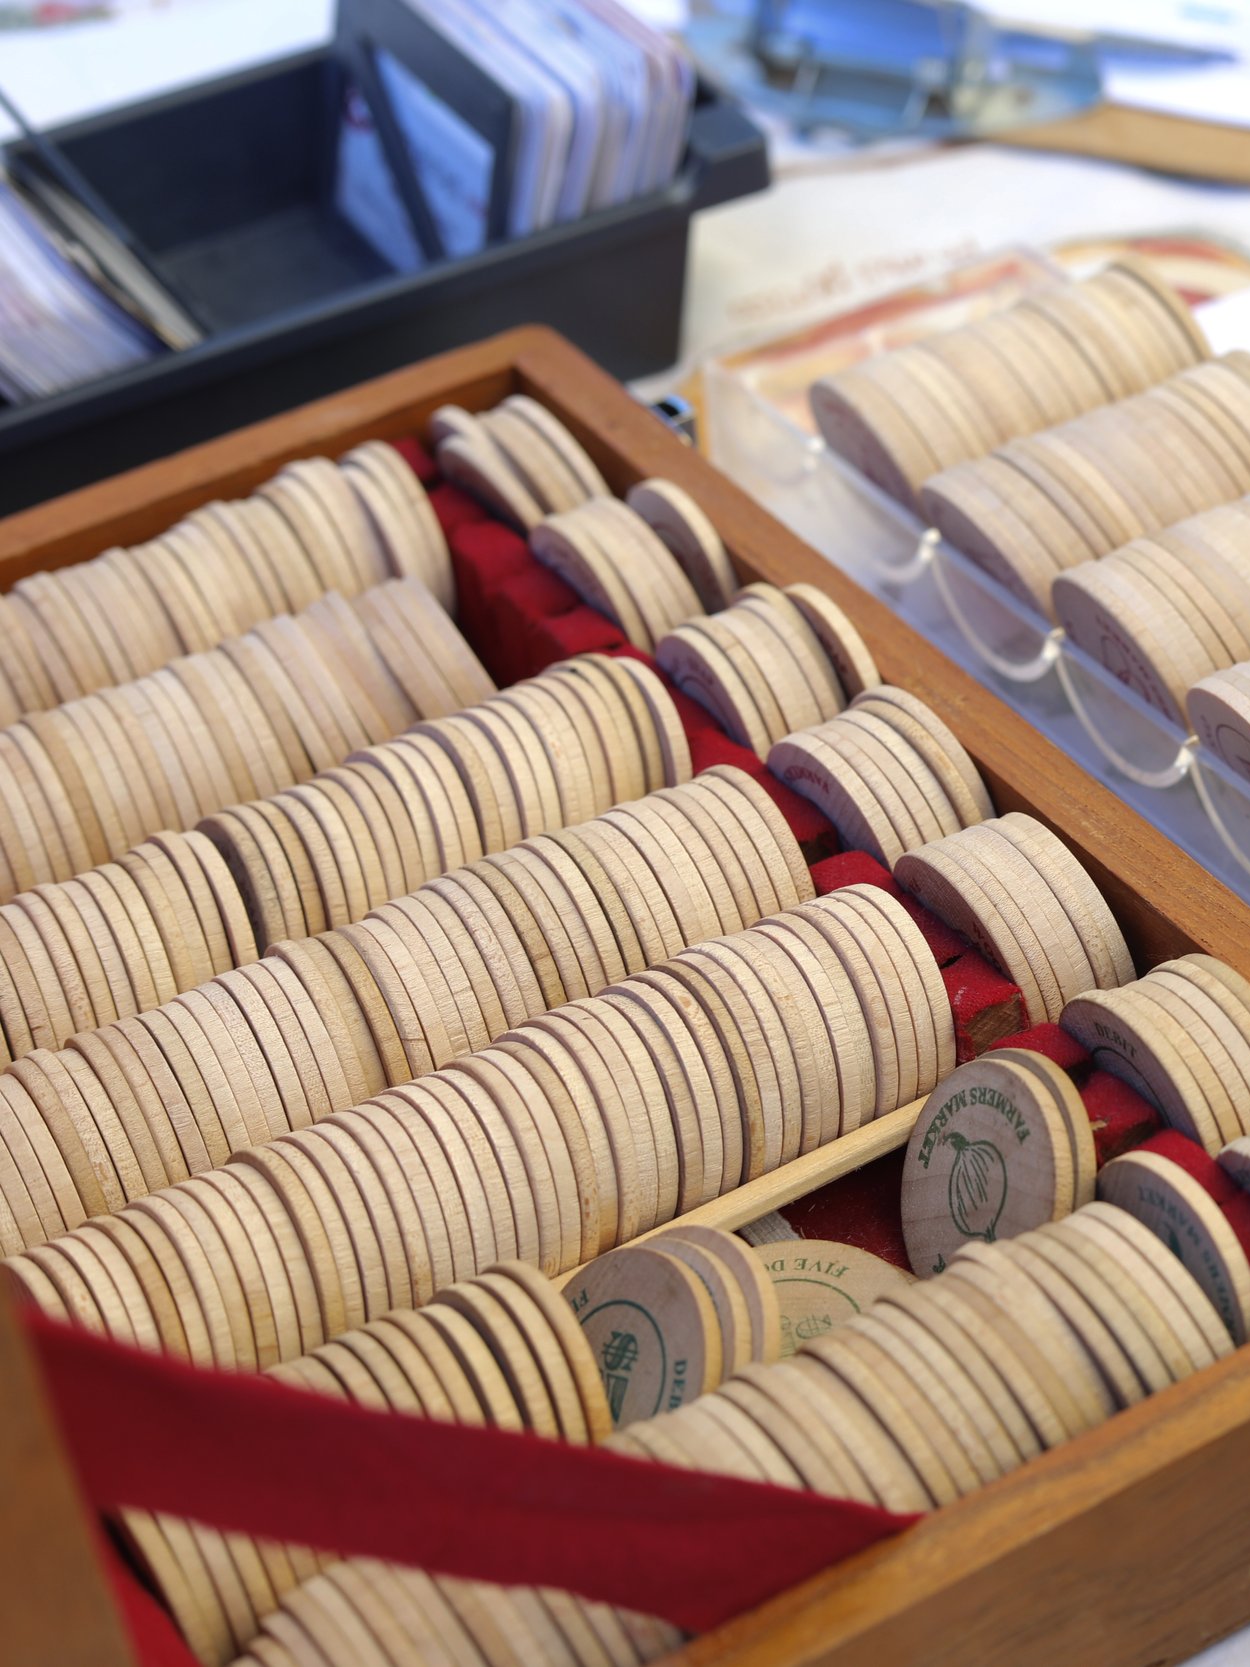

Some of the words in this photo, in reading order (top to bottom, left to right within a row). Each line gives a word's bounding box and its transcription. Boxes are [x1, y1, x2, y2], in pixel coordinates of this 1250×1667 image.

[917, 1090, 966, 1170] MARKET
[968, 1086, 1032, 1148] FARMERS
[794, 1257, 850, 1279] FIVE
